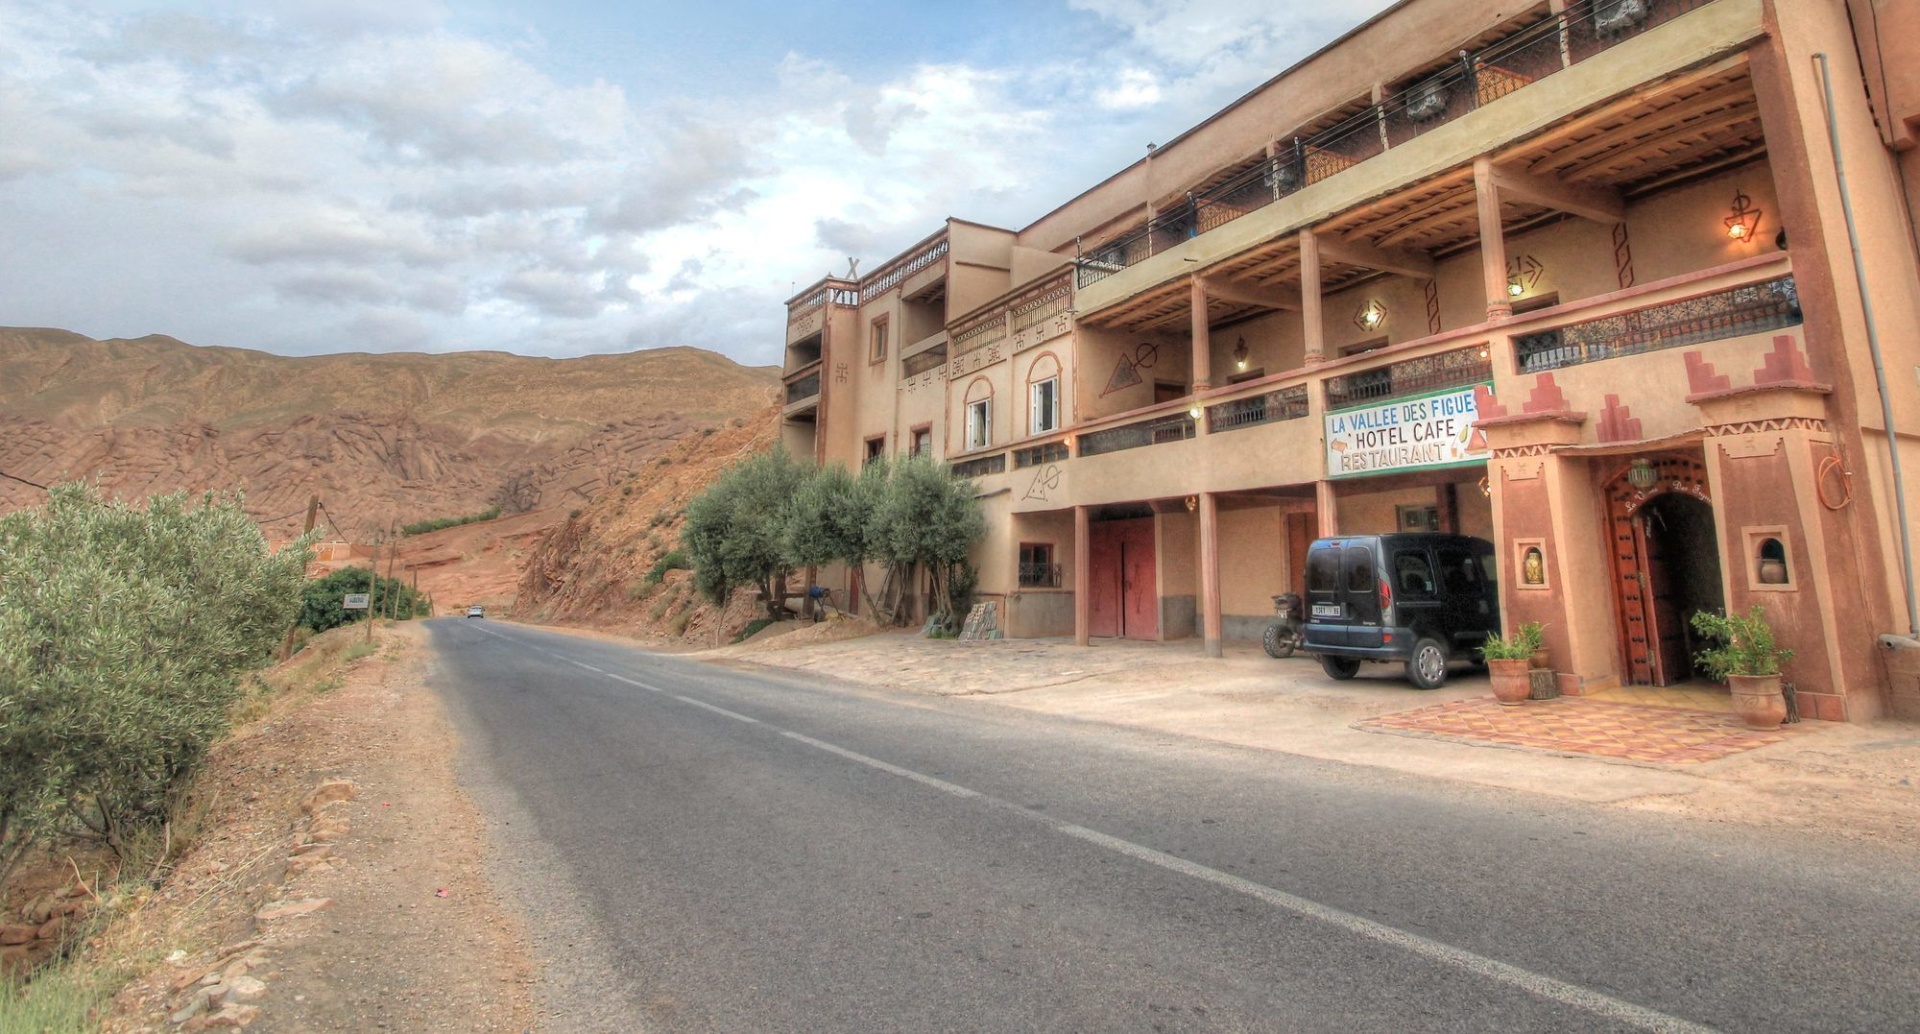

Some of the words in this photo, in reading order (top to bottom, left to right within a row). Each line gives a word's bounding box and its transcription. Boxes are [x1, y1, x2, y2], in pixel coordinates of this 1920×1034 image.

[1332, 418, 1346, 434] LA
[1350, 407, 1399, 430] VALLEE
[1403, 403, 1427, 422] DES
[1432, 393, 1477, 417] FIGUE
[1356, 427, 1408, 449] HOTEL
[1414, 418, 1456, 442] CAFE
[1341, 443, 1446, 471] RESTAURANT
